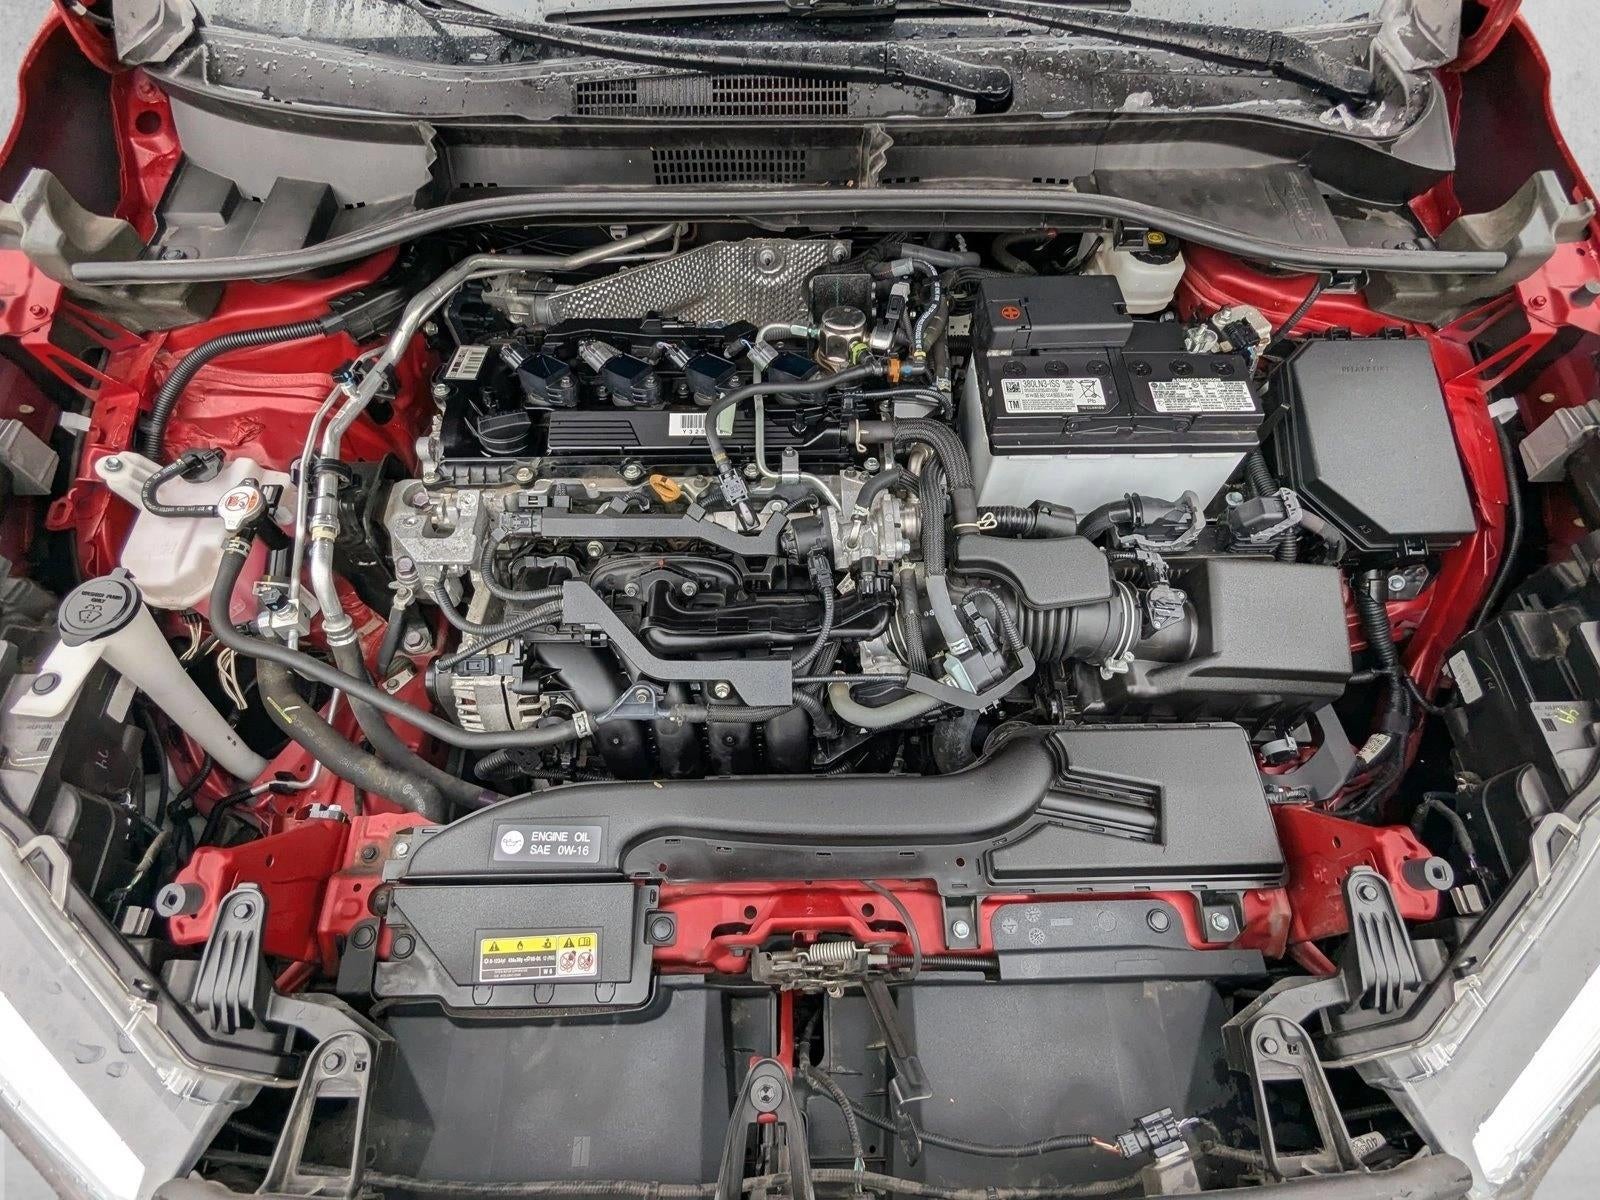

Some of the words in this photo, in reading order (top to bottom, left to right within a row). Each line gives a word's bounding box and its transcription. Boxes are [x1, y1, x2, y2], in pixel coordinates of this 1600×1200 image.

[1008, 401, 1020, 410] TM
[531, 831, 569, 842] ENGINE
[574, 832, 591, 842] OIL
[530, 844, 551, 855] SAE
[557, 845, 589, 856] 0W-16
